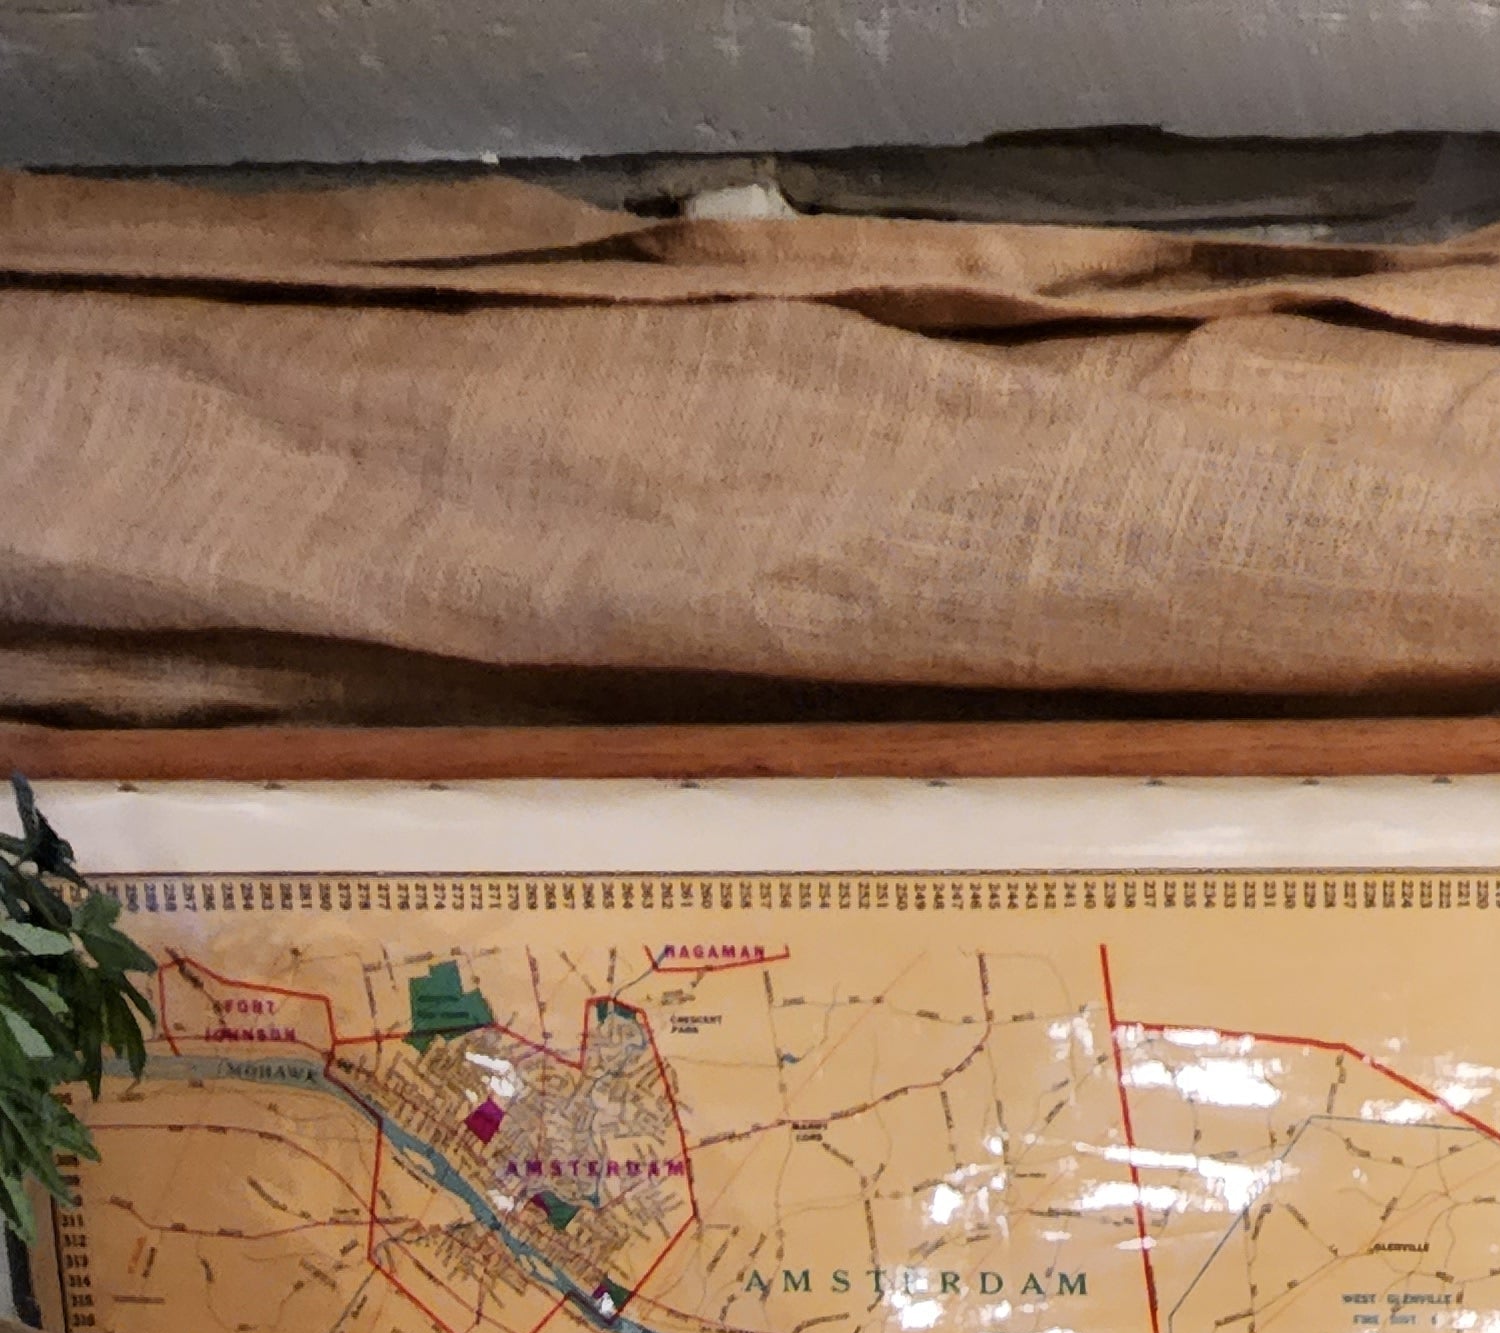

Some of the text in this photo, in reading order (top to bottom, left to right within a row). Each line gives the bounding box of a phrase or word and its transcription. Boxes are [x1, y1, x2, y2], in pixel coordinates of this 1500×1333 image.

[228, 1062, 316, 1083] MOHAWK
[506, 1158, 685, 1176] AMSTERDAM
[744, 1269, 1089, 1295] AMSTERDAM
